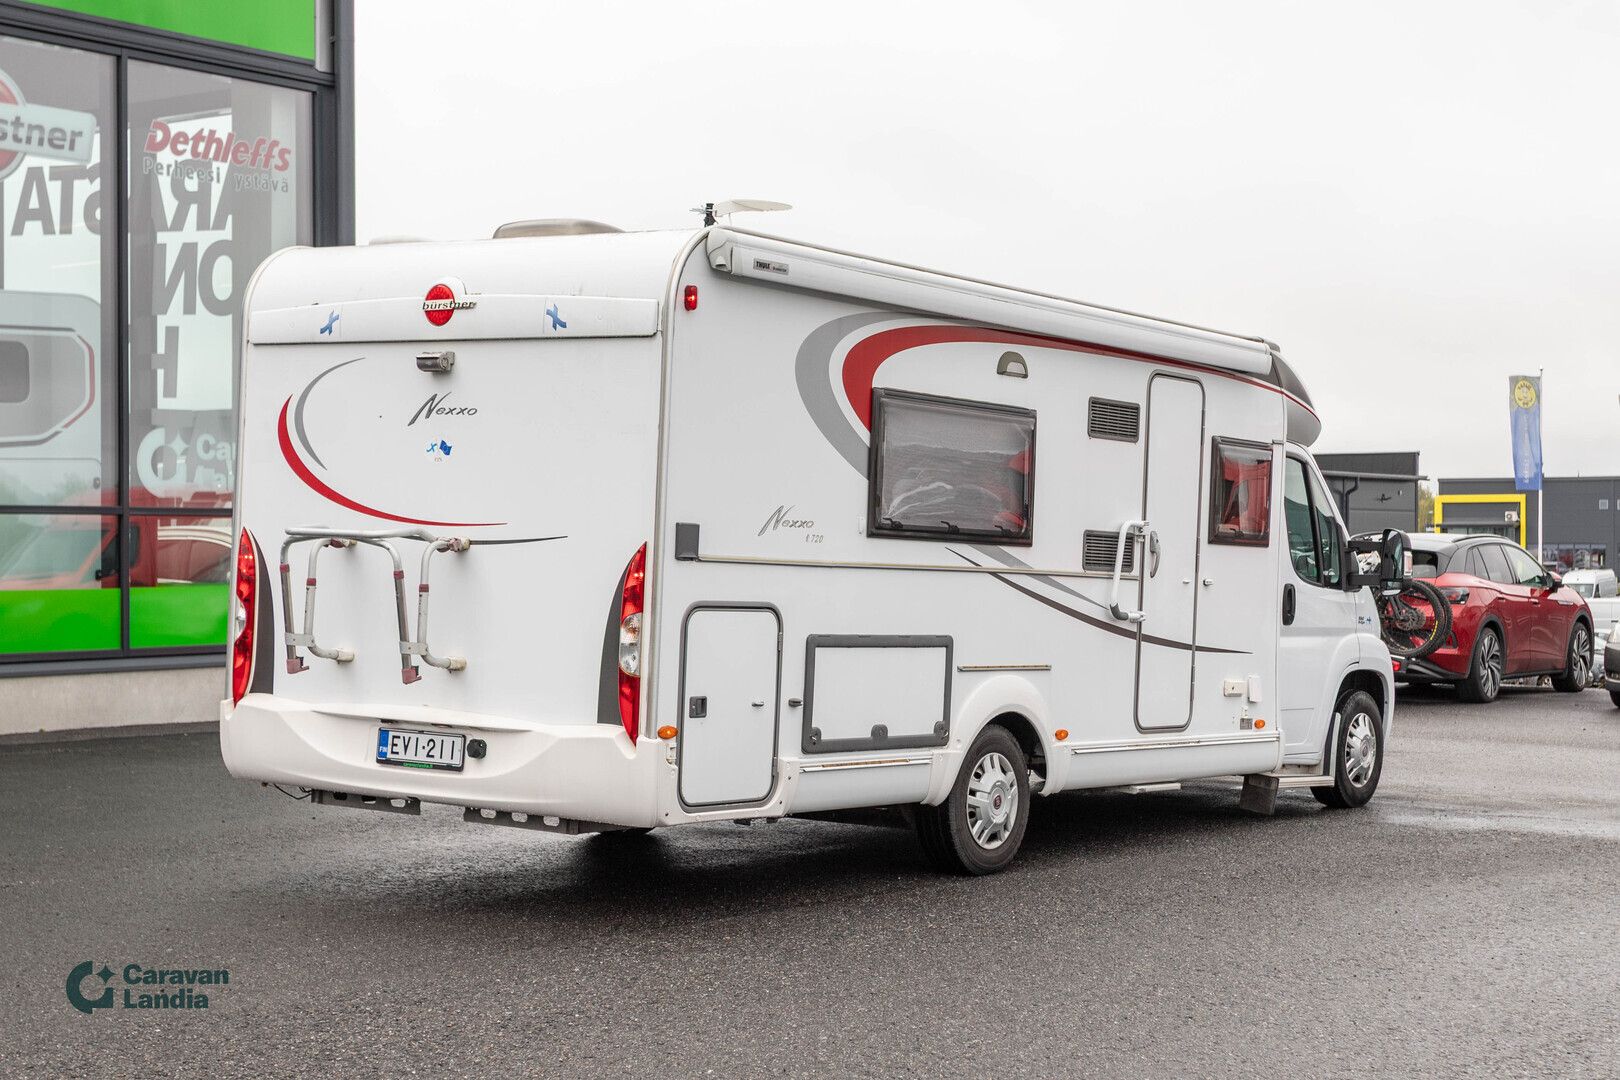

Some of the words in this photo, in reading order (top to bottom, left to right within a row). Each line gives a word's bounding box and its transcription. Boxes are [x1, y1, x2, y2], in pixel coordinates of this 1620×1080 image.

[144, 119, 292, 172] Dethleffs
[143, 156, 220, 184] Perheesi
[232, 172, 289, 193] ystävä
[422, 300, 477, 310] bürstner
[407, 391, 478, 427] Nexxo
[757, 504, 815, 537] Nexxo
